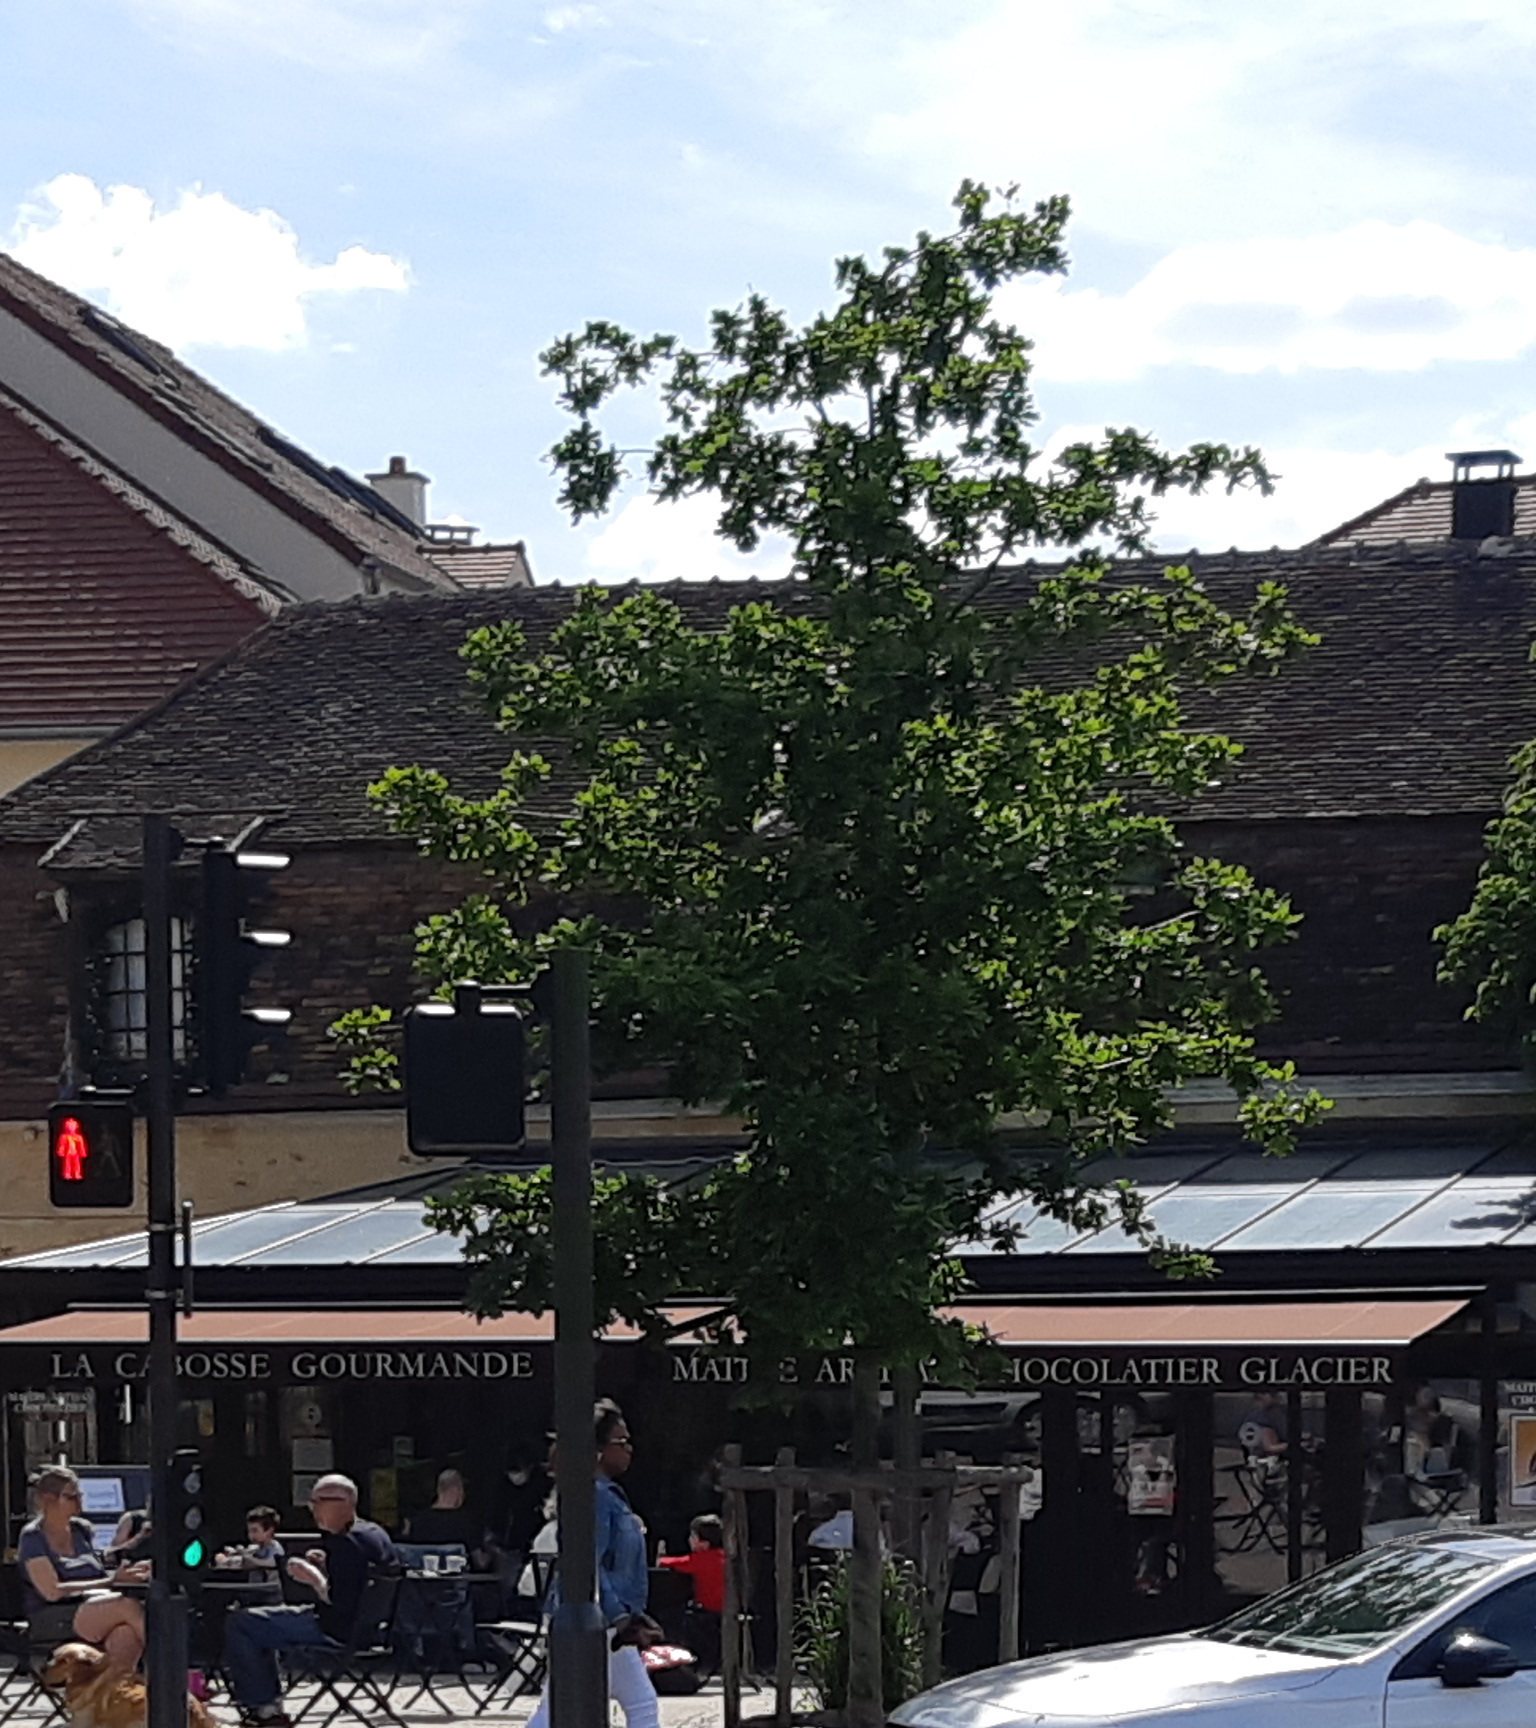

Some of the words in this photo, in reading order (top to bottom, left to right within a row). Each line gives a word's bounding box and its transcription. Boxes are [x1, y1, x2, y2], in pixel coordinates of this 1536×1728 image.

[51, 1353, 95, 1378] LA
[291, 1352, 534, 1379] GOURMANDE
[672, 1356, 799, 1383] MAITE
[978, 1357, 1223, 1385] HOCOLATIER
[1240, 1356, 1395, 1385] GLACIER
